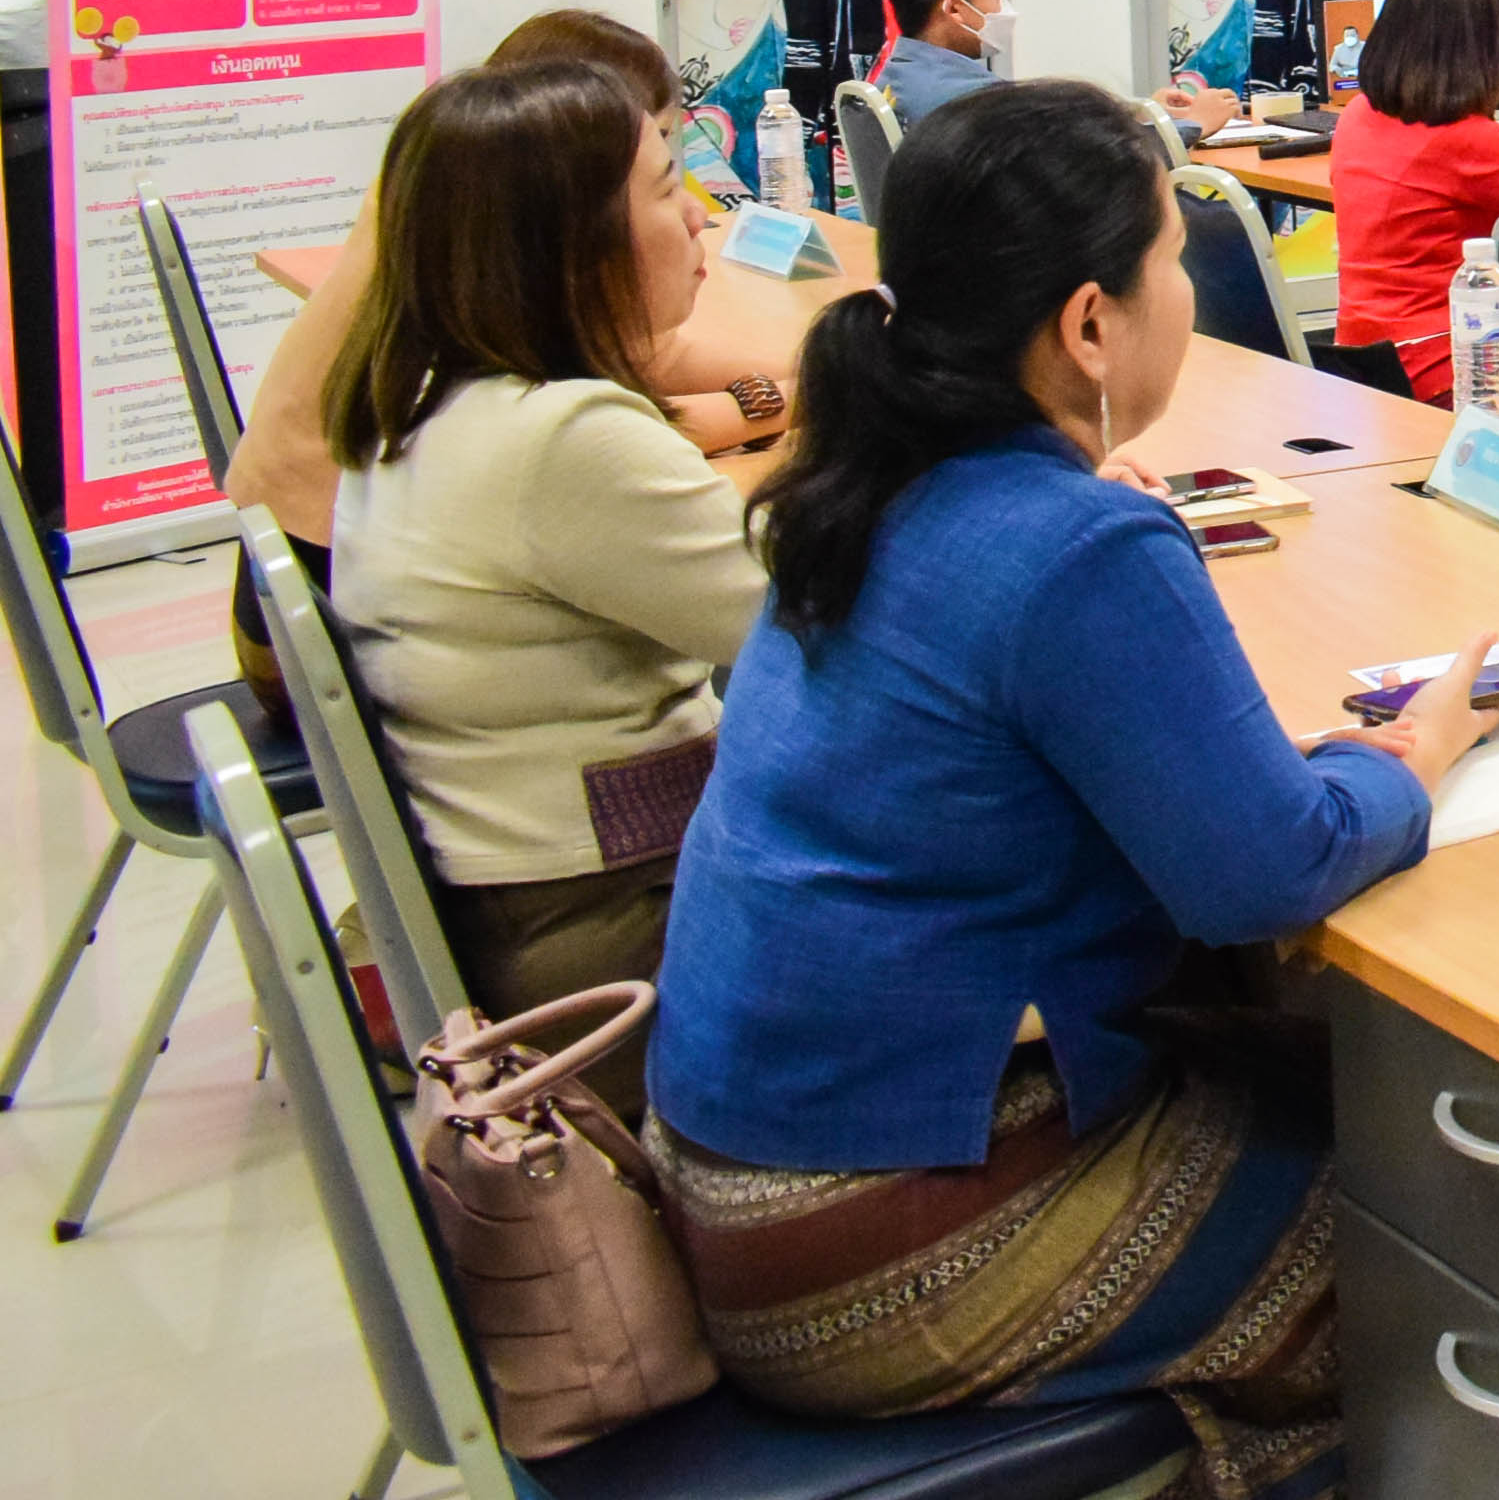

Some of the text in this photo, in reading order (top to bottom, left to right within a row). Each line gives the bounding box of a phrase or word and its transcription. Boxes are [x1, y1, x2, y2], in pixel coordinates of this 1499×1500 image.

[211, 53, 301, 80] เงินอุดหนุน
